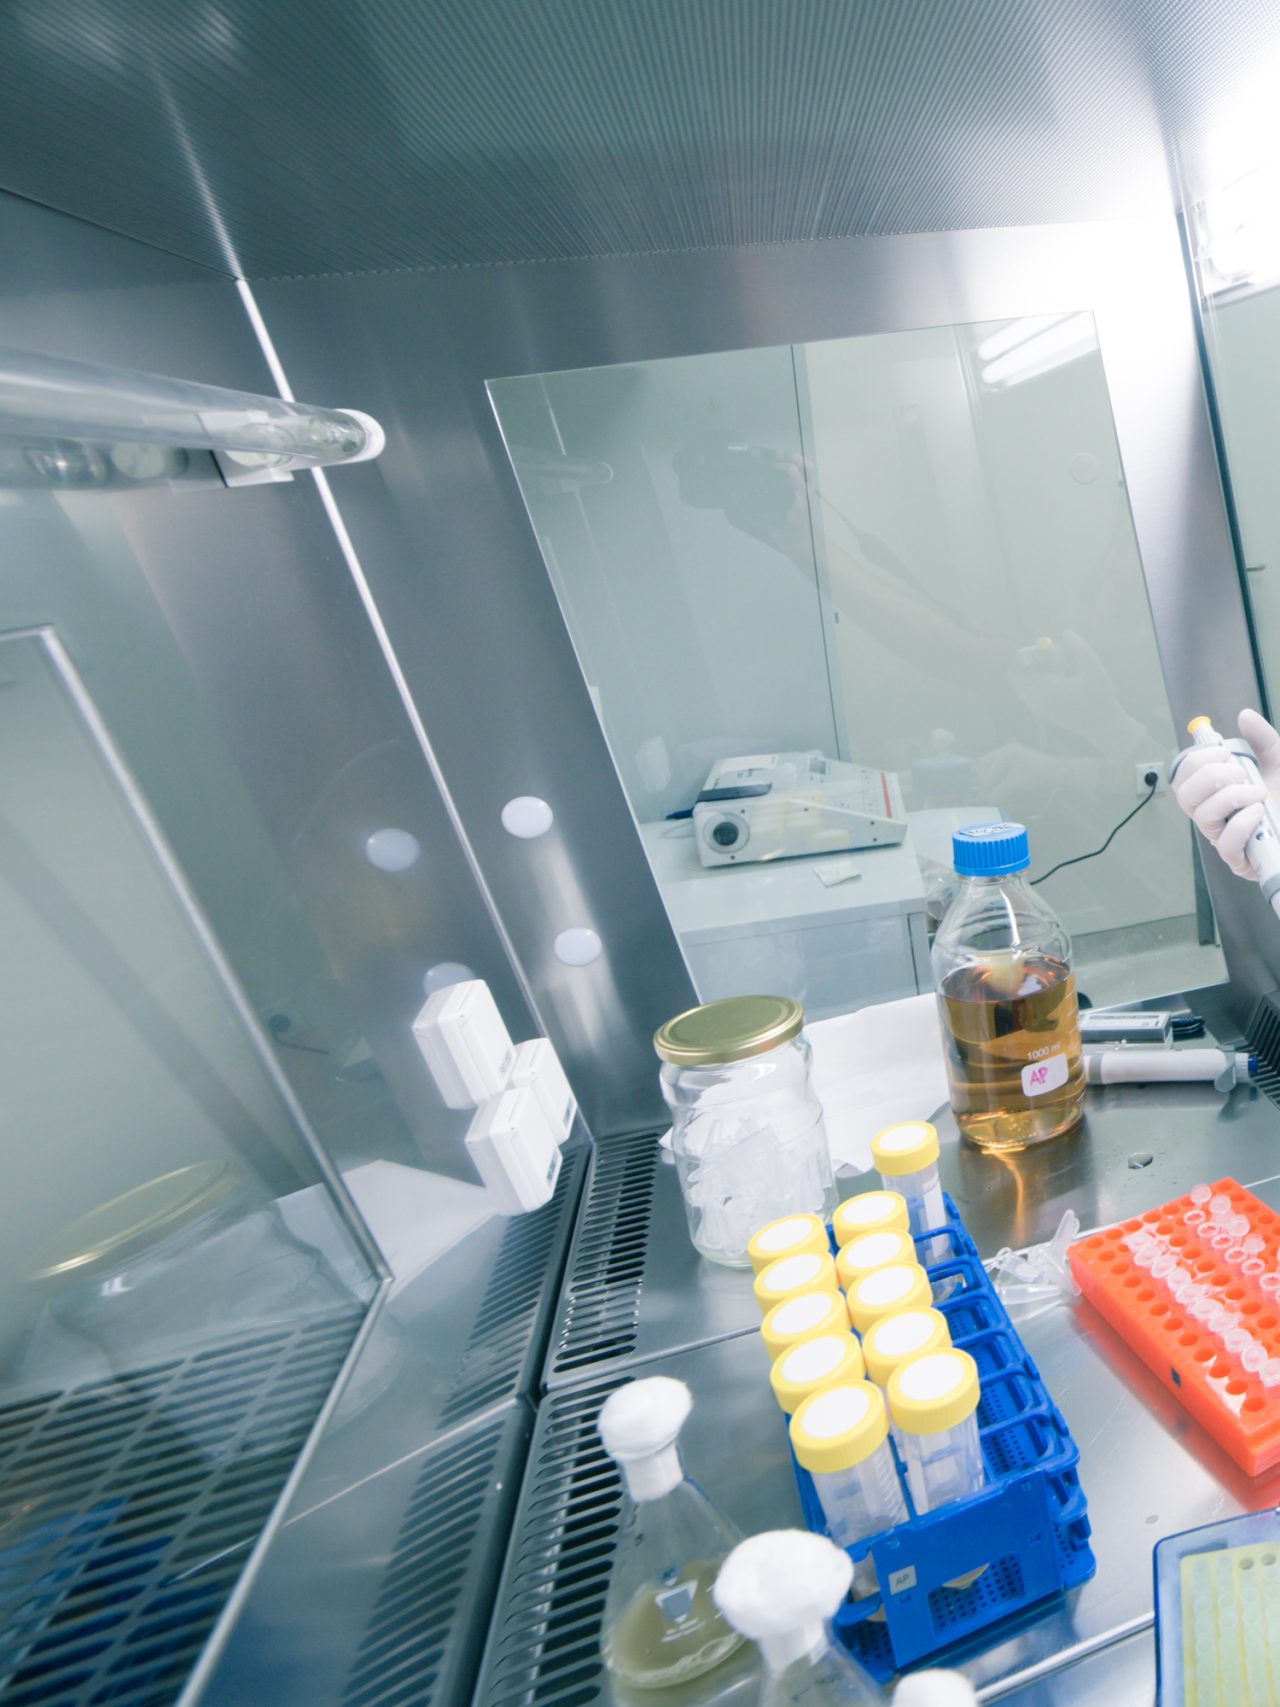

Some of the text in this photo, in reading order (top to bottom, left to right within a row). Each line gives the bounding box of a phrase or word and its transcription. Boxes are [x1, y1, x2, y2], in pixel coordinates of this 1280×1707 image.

[1028, 1046, 1049, 1060] 1000
[1030, 1066, 1048, 1087] AP
[895, 1573, 910, 1587] AP
